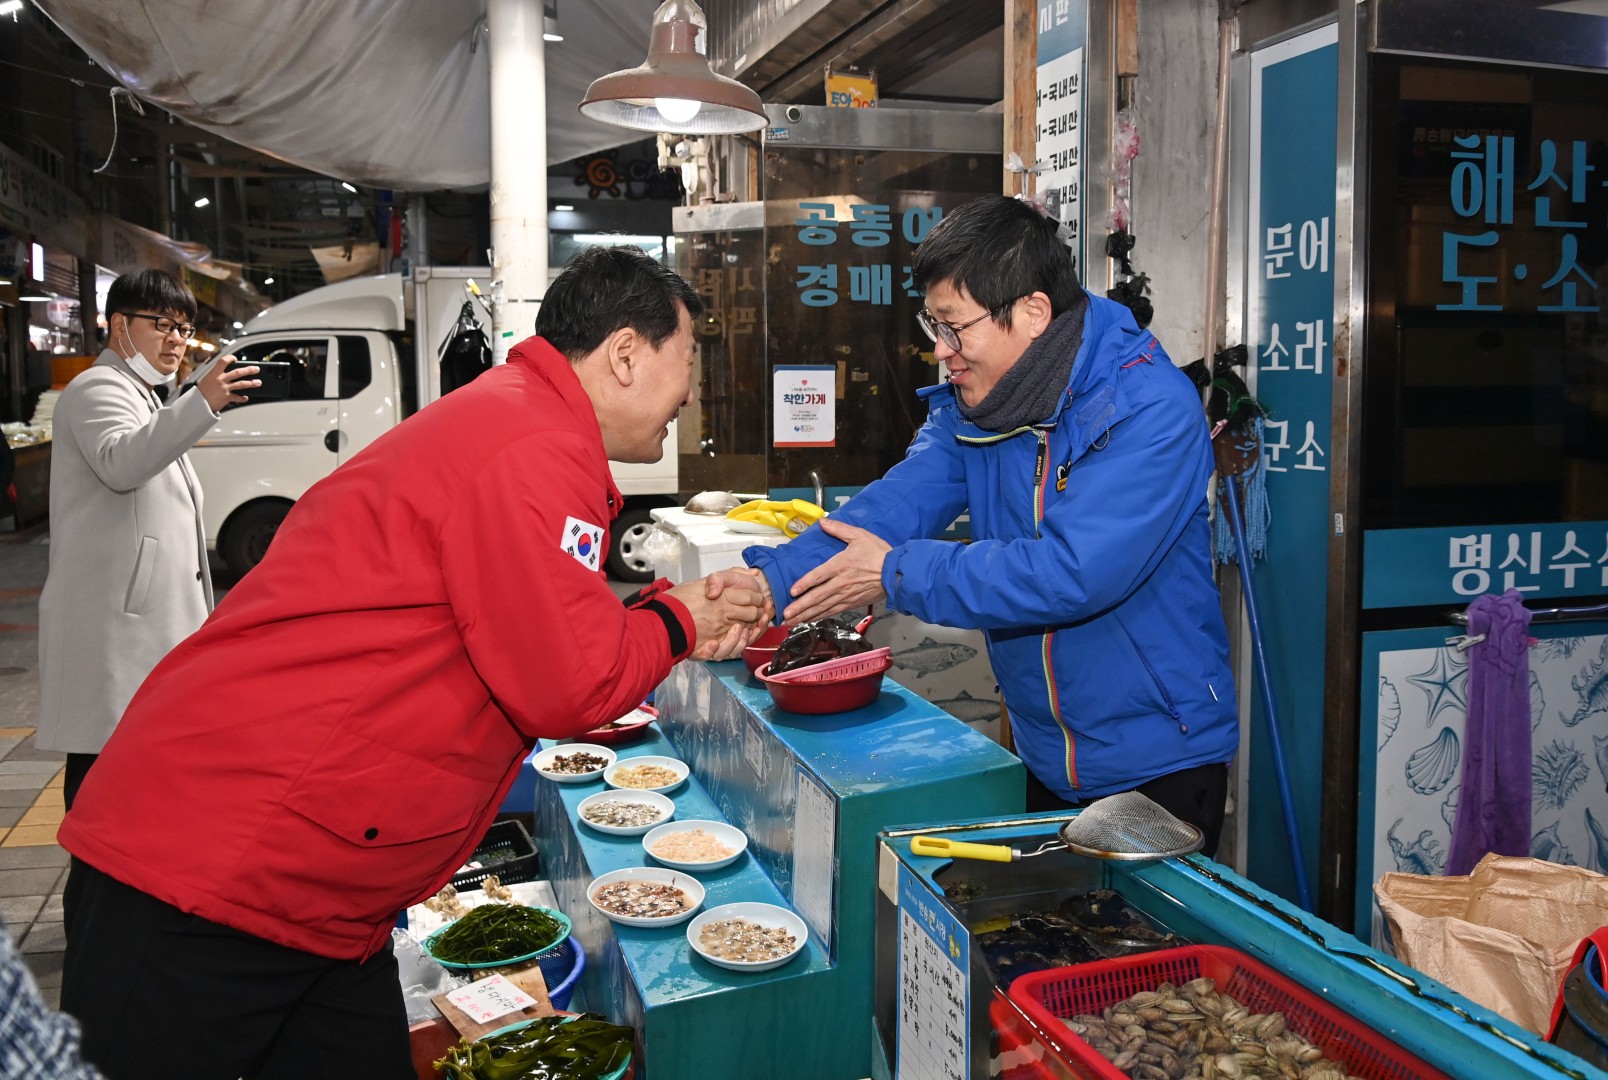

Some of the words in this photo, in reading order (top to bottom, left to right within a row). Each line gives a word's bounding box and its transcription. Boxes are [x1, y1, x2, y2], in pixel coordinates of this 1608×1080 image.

[1451, 134, 1608, 228] 해산
[1264, 216, 1329, 279] 문어
[1261, 319, 1327, 374] 소라
[783, 393, 826, 405] 착한가게
[1449, 530, 1608, 596] 명신수
